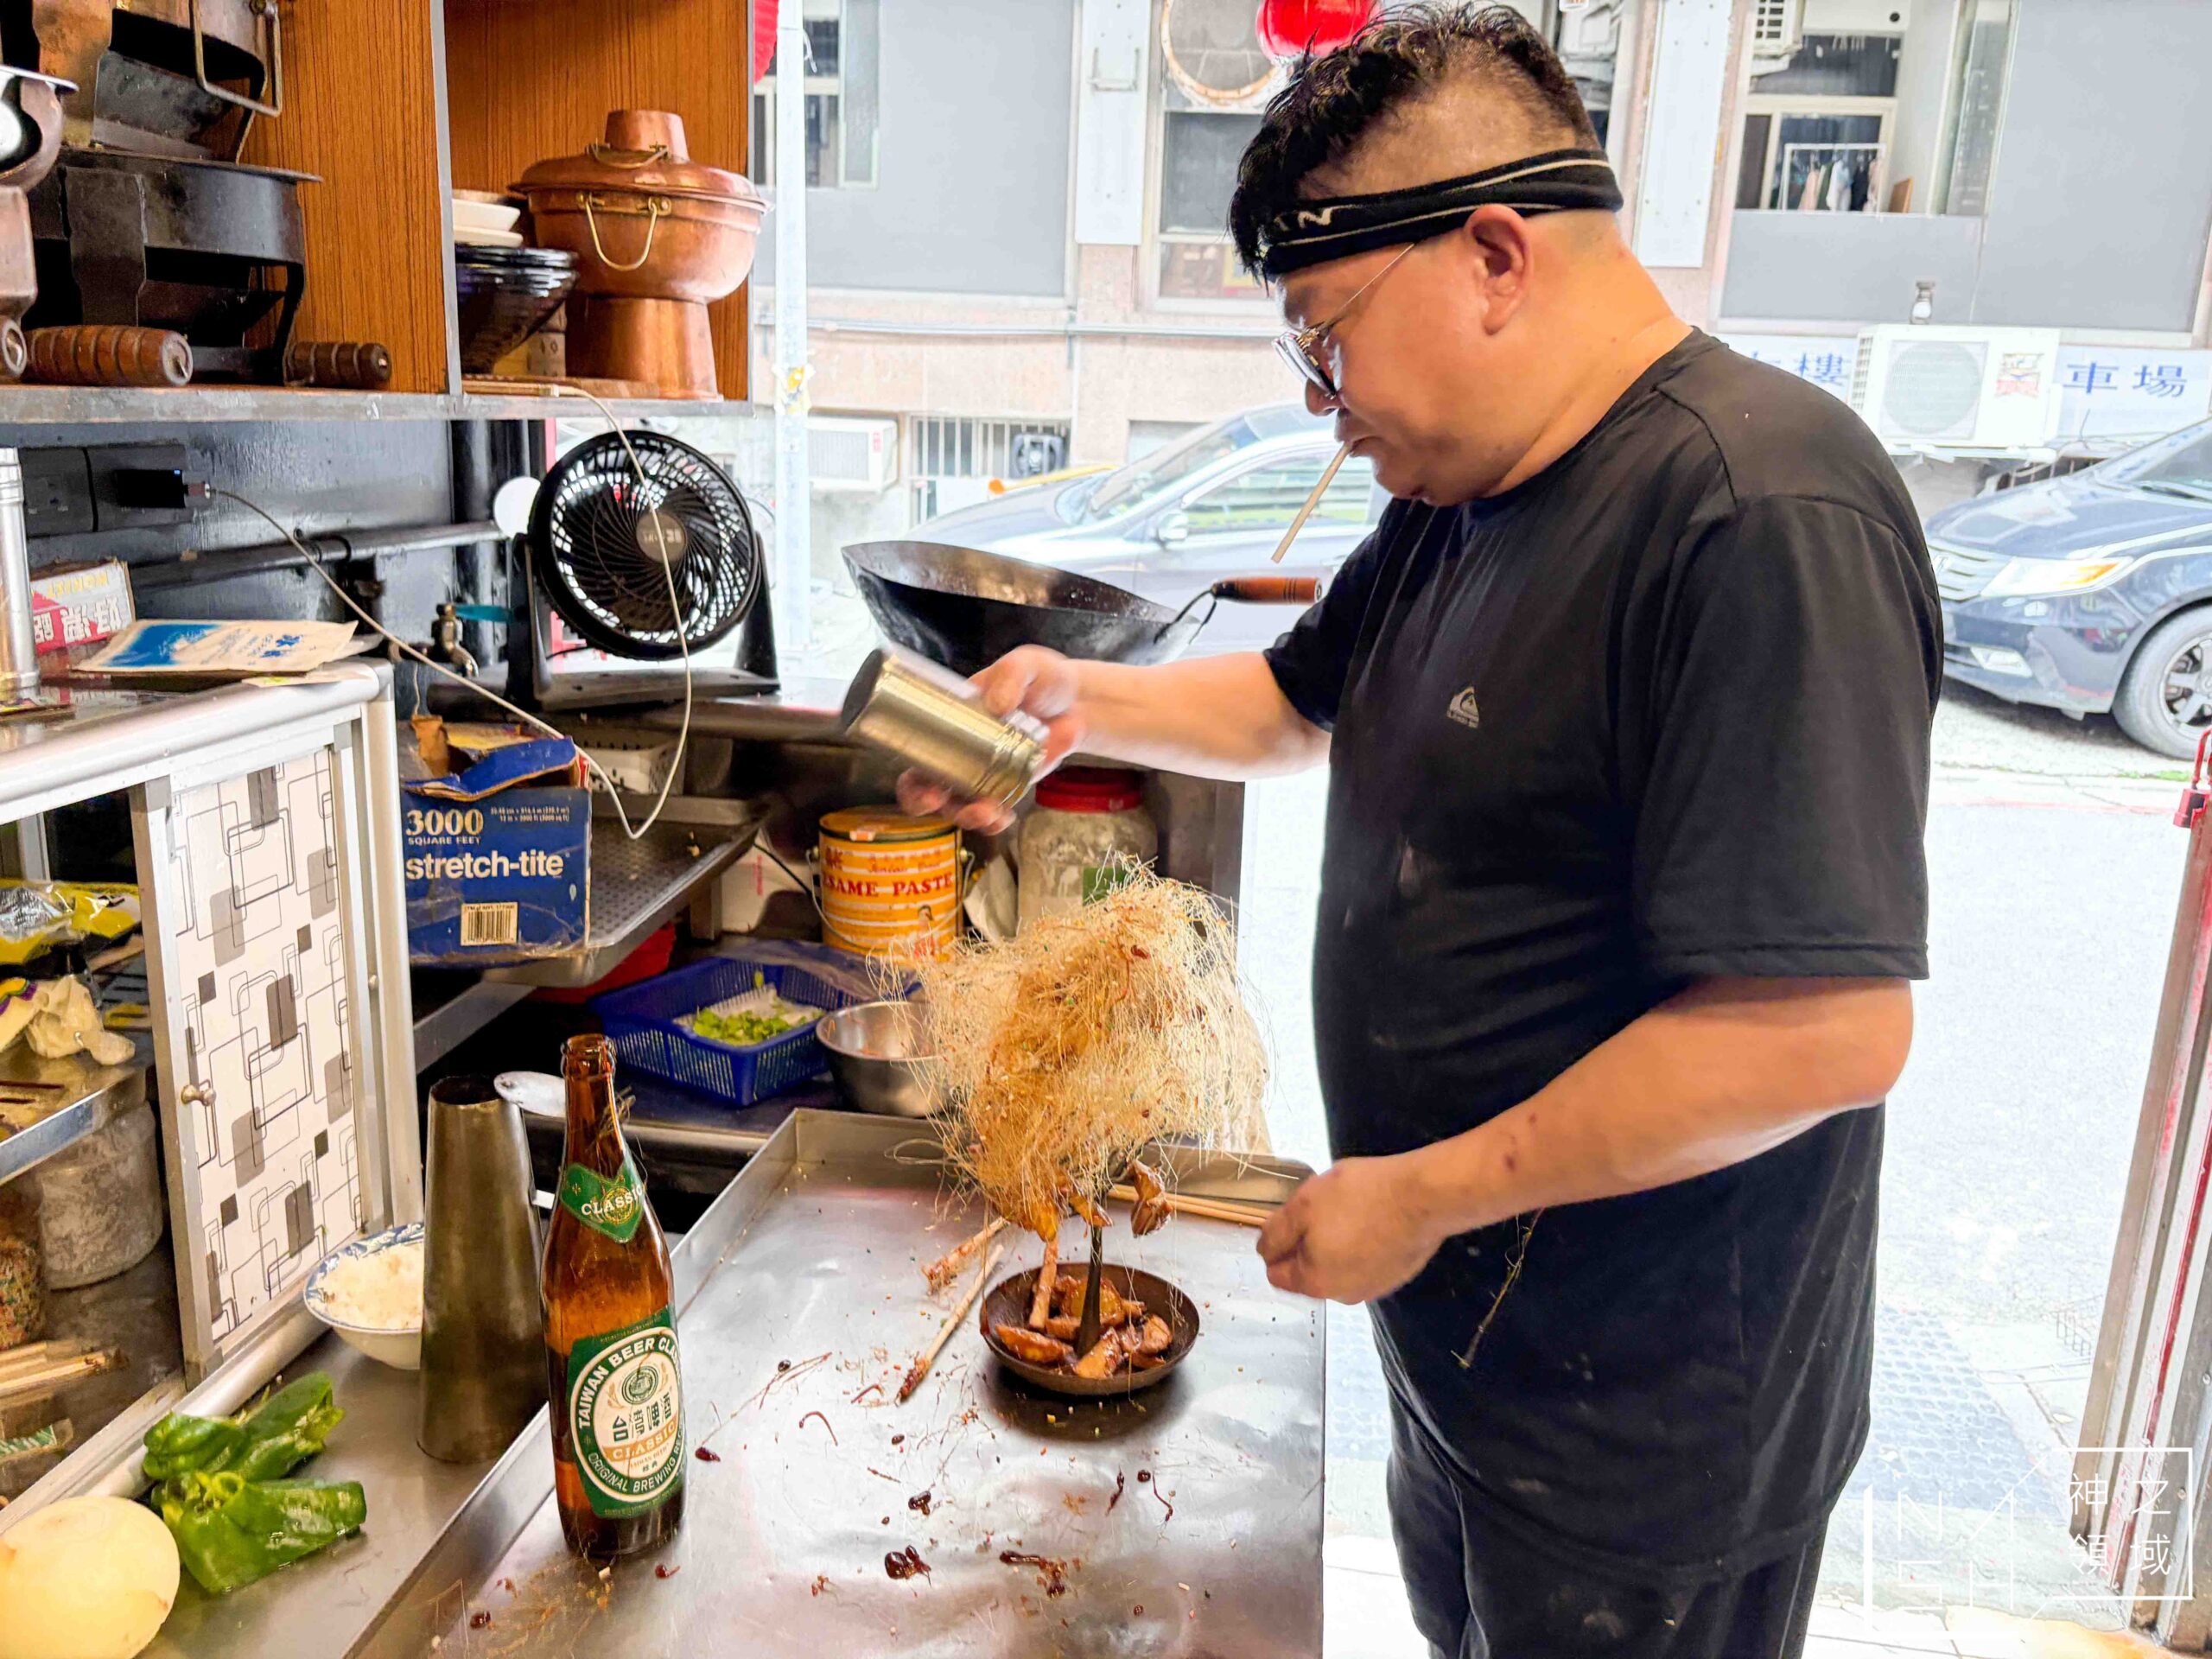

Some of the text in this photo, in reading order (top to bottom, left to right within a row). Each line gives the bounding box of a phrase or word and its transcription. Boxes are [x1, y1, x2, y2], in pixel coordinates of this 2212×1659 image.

[2063, 361, 2188, 397] 車場
[405, 809, 484, 836] 3000
[408, 836, 482, 845] SQUARE FEET
[405, 849, 564, 880] stretch-tite
[893, 871, 953, 897] PASTE
[578, 1364, 610, 1429] TAIWAN
[608, 1337, 655, 1369] BEER
[612, 1424, 676, 1460] CLASSIC
[588, 1452, 629, 1492] ORIGINAL
[632, 1456, 677, 1494] BREWING
